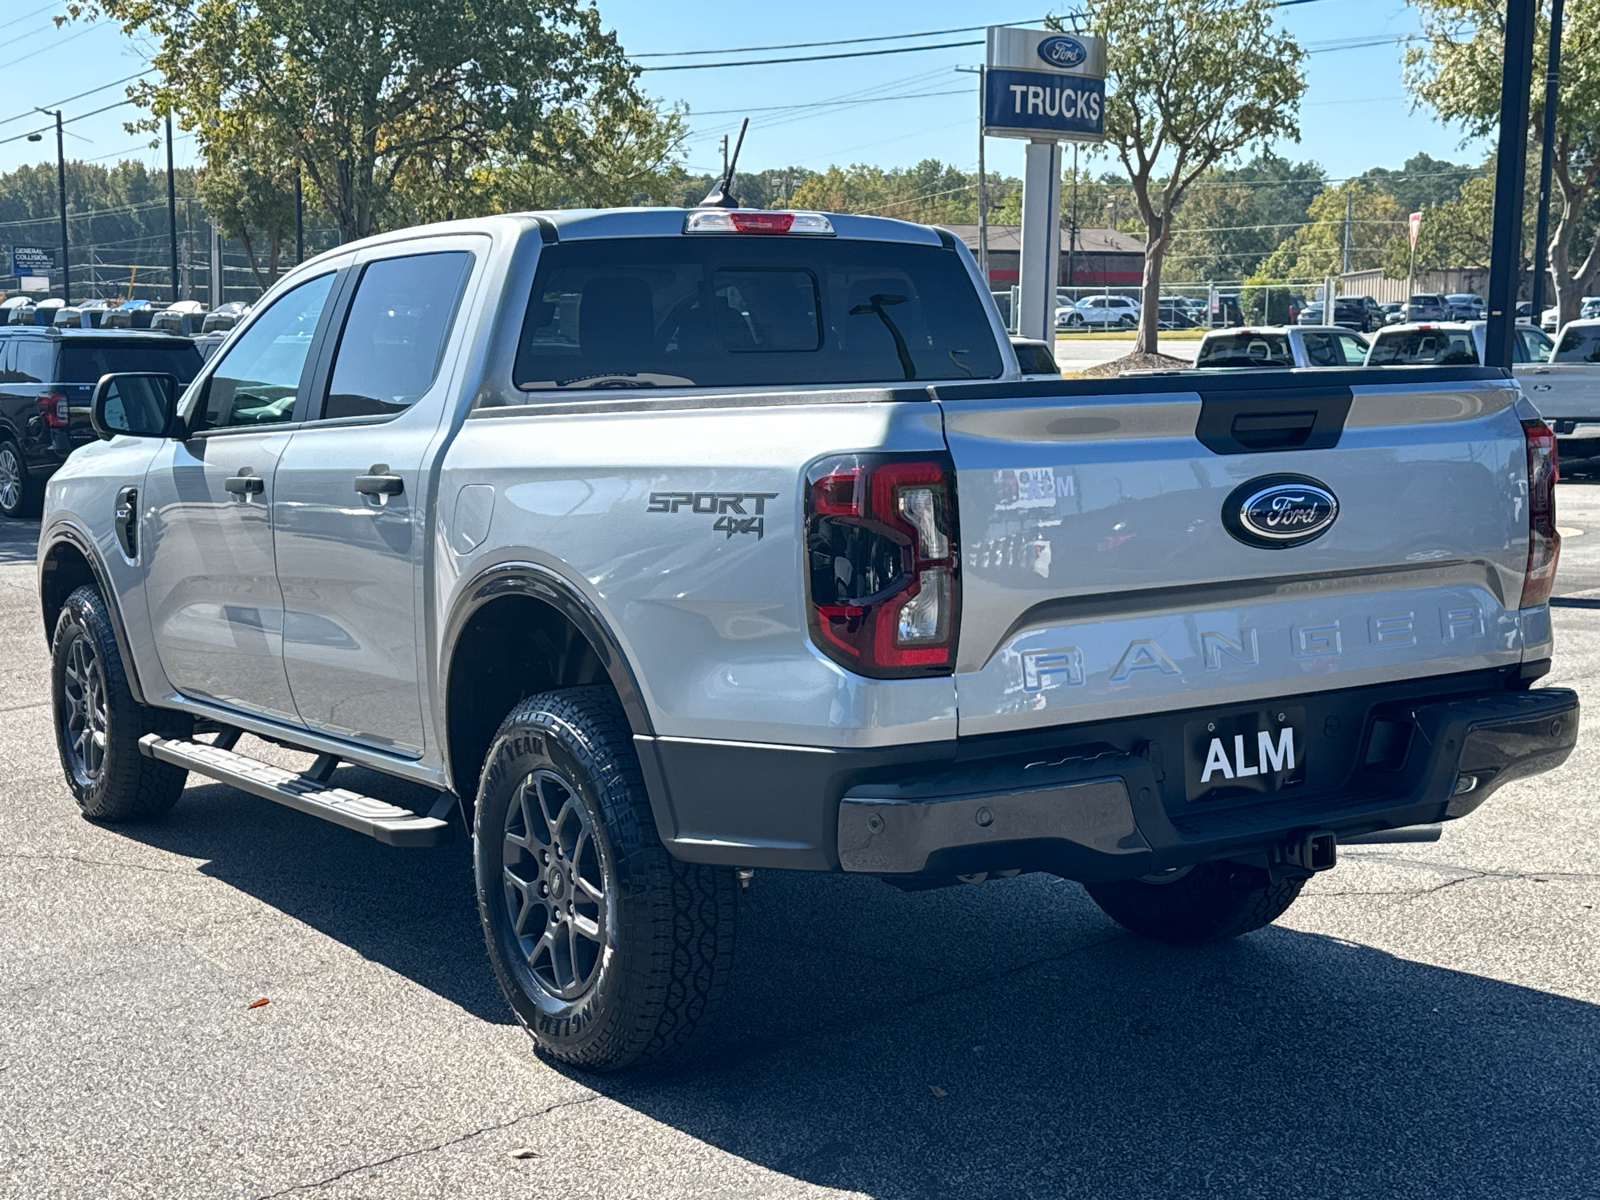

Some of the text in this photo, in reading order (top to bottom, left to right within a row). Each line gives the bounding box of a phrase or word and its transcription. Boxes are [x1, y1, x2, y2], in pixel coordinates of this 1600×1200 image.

[1051, 41, 1079, 61] Ford
[1009, 84, 1100, 121] TRUCKS
[14, 247, 44, 255] GENERAL
[646, 491, 780, 516] SPORT
[1266, 496, 1318, 527] Ford
[1019, 603, 1487, 692] RANGER
[1200, 727, 1295, 783] ALM
